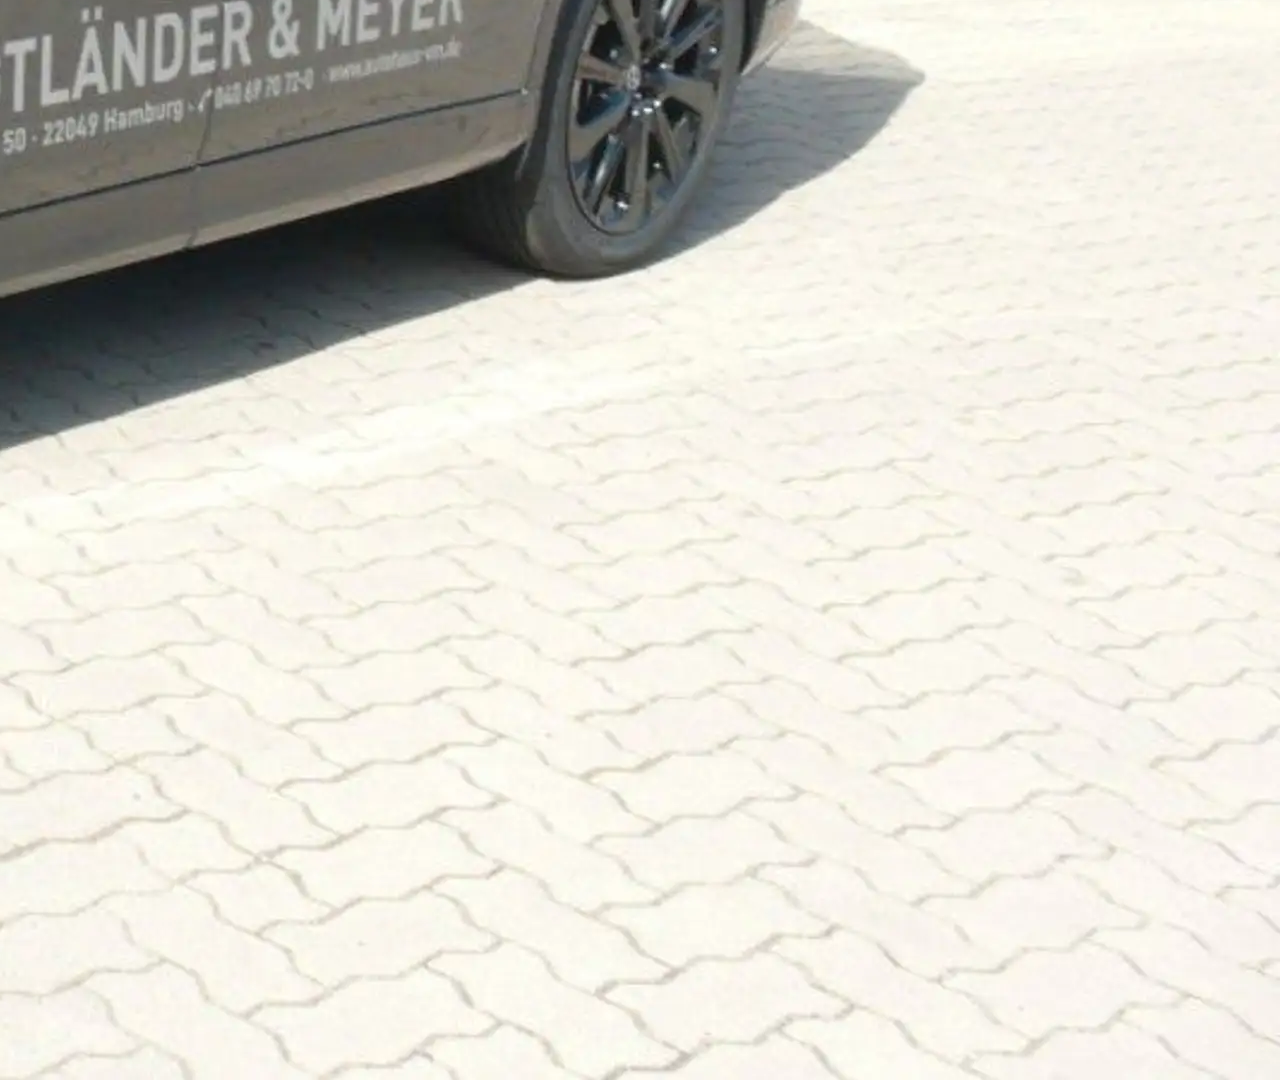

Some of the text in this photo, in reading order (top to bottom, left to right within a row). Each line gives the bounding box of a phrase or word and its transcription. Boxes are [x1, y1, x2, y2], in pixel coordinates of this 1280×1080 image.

[2, 126, 27, 157] 50
[42, 112, 98, 148] 22049
[104, 97, 185, 134] Hamburg
